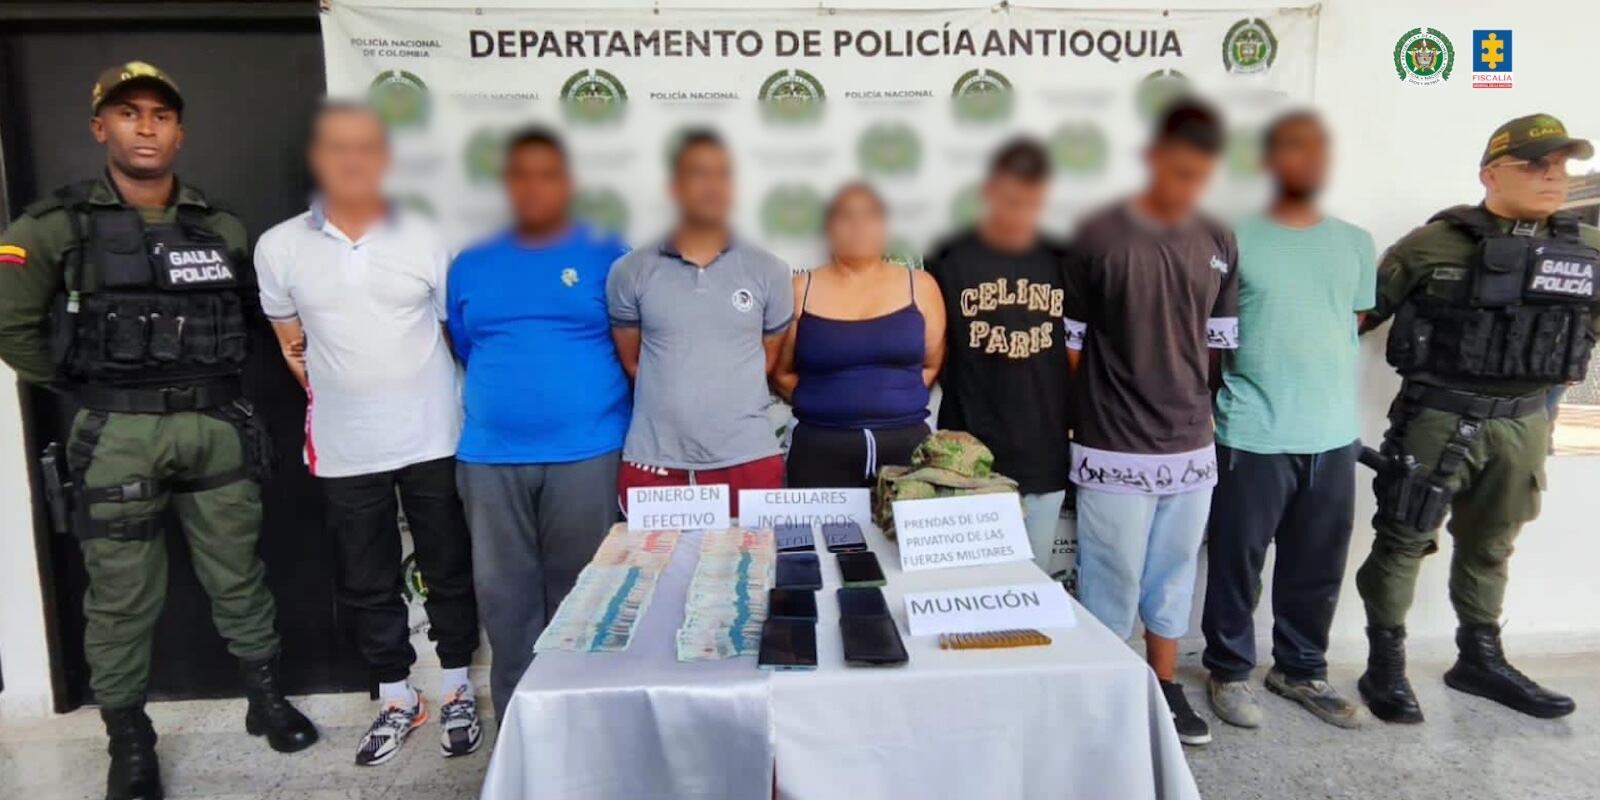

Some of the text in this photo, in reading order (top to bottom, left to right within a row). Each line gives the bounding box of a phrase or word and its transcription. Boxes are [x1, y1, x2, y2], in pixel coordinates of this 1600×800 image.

[391, 40, 441, 48] NACIONAL
[470, 22, 1183, 63] DEPARTAMENTO DE POLICÍA ANTIOQUIA
[363, 49, 430, 58] DE COLOMBIA
[650, 90, 740, 100] POLICÍA NACIONAL
[845, 90, 935, 99] POLICÍA NACIONAL
[169, 250, 223, 266] GAULA
[169, 264, 233, 284] POLICÍA
[1541, 259, 1593, 278] GAULA
[1532, 275, 1593, 296] POLICÍA
[960, 277, 1065, 317] CELINE
[969, 320, 1054, 358] PARIS
[636, 487, 720, 503] DINERO EN
[764, 491, 848, 504] CELULARES
[642, 512, 715, 528] EFECTIVO
[904, 511, 1000, 530] PRENDAS DE USO
[906, 528, 1005, 548] PRIVATIVO DE LAS
[903, 545, 1015, 567] FUERZAS MILITARES
[911, 589, 1041, 615] MUNICIÓN
